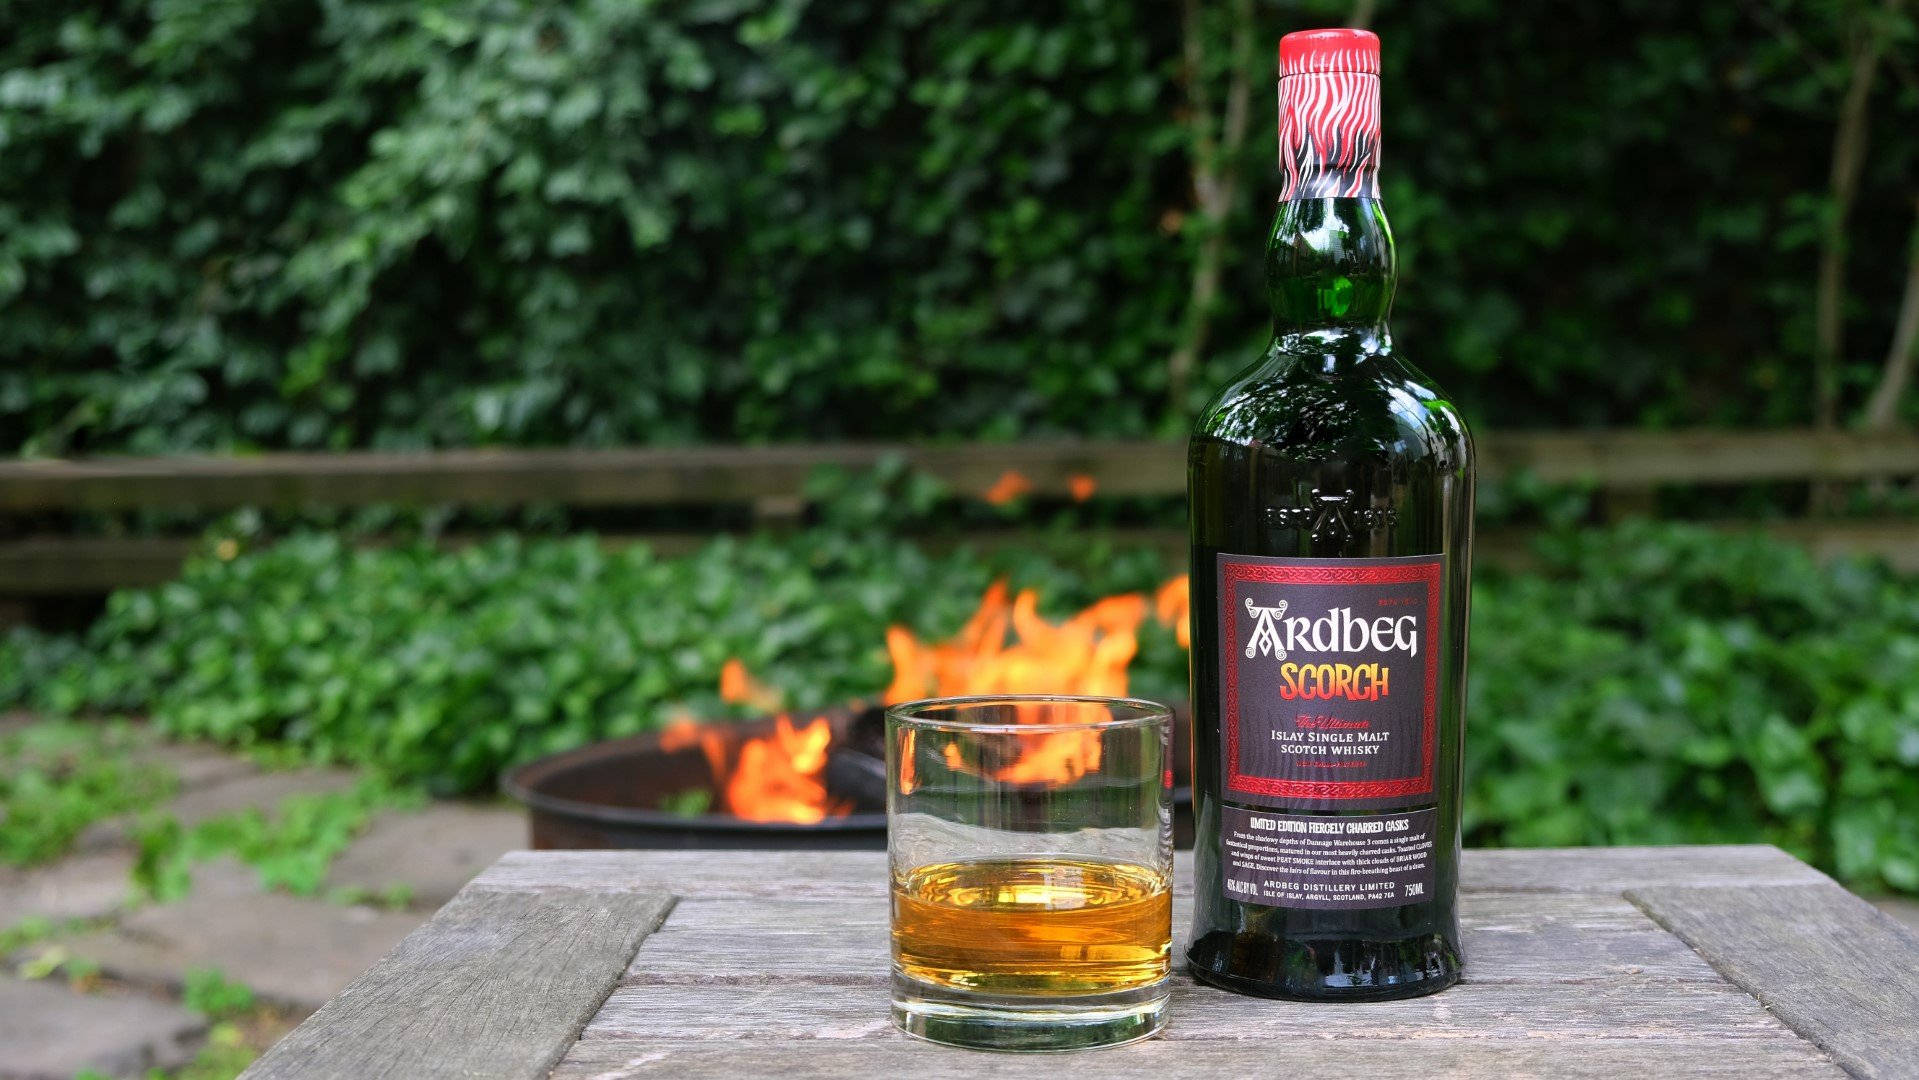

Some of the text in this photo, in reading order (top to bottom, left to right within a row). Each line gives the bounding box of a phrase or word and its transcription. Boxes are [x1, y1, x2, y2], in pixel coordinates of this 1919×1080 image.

[1280, 662, 1389, 701] SCORCH
[1271, 730, 1390, 742] ISLAY SINGLE MALT
[1280, 744, 1379, 755] SCOTCH WHISKY
[1250, 816, 1409, 834] LIMITED EDITION FIERCELY CHARRED CASKS
[1233, 830, 1246, 840] From
[1255, 834, 1278, 844] shadowy
[1279, 838, 1298, 846] depths
[1306, 839, 1332, 848] Dunnage
[1366, 838, 1371, 846] 3
[1231, 850, 1240, 858] and
[1315, 858, 1340, 866] interlace
[1338, 848, 1358, 857] heavily
[1256, 864, 1280, 872] Discover
[1350, 867, 1388, 875] fire-breathing
[1264, 880, 1395, 892] ARDBEG DISTILLERY LIMITED
[1404, 883, 1424, 897] 750ML
[1264, 890, 1275, 898] ISLE
